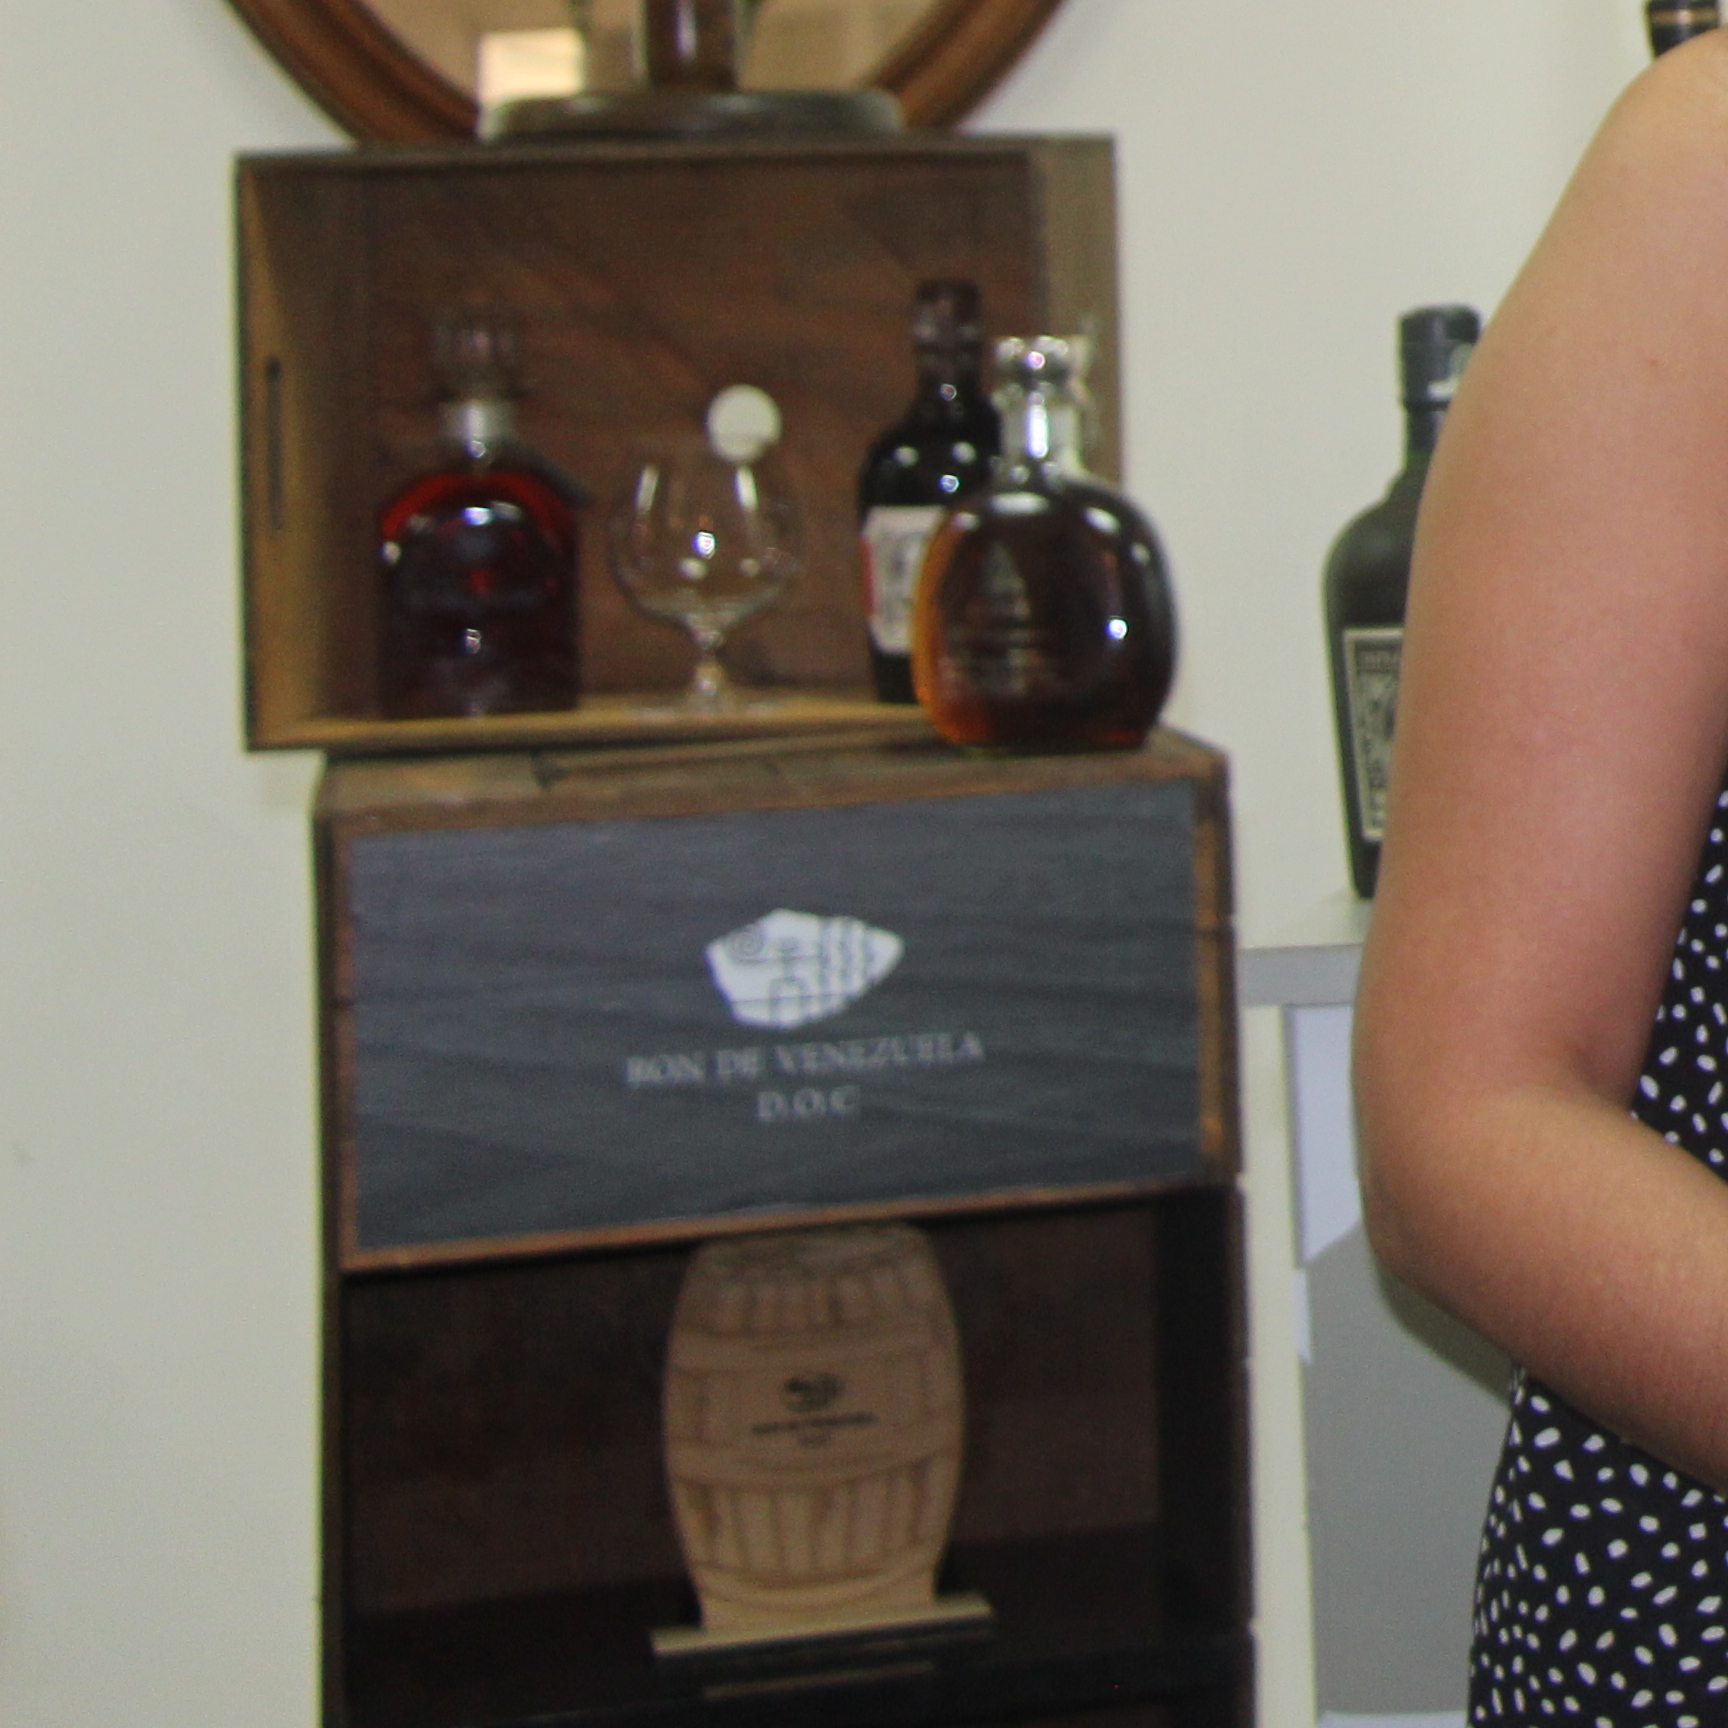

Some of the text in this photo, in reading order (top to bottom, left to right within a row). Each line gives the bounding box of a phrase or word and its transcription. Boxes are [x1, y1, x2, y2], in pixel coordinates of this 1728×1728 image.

[626, 1030, 986, 1084] RON DE VENEZUELA
